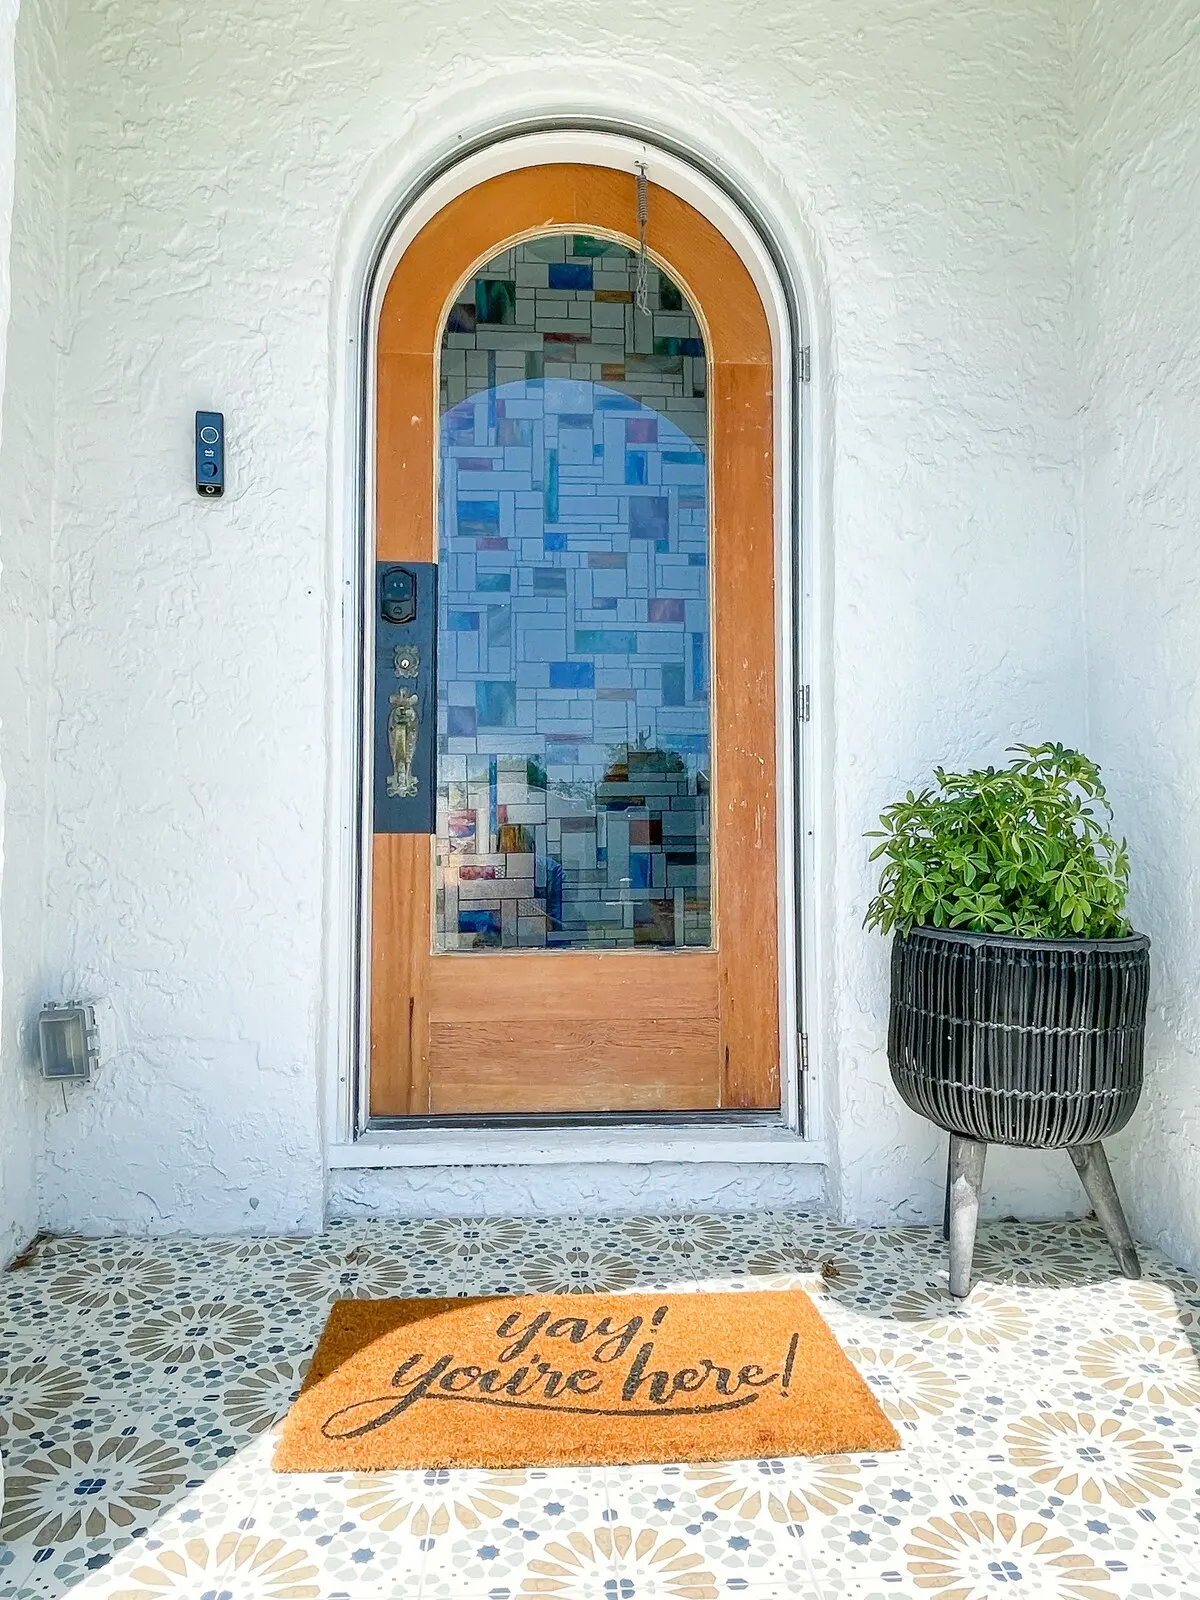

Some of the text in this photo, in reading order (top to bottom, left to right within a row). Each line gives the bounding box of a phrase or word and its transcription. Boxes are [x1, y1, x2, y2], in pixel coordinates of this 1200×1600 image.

[497, 1306, 669, 1363] yay!
[321, 1333, 799, 1439] you're here!
